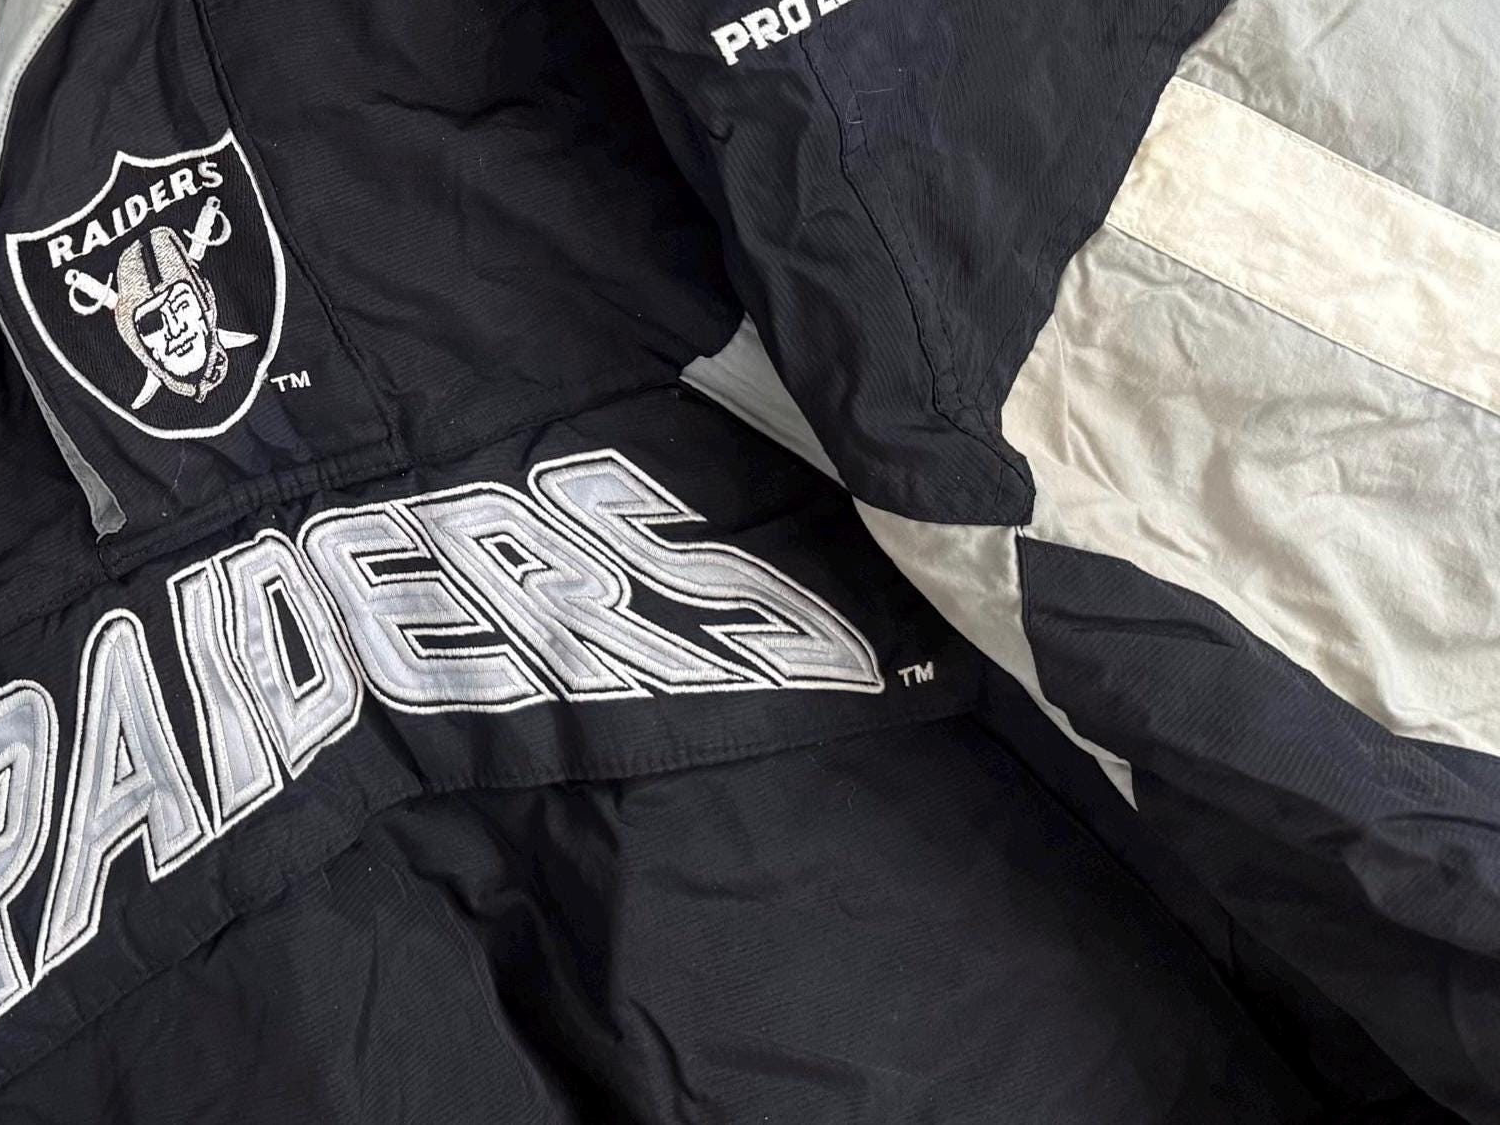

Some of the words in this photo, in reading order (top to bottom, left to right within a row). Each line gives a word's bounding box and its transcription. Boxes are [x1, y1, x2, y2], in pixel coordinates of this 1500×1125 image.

[46, 160, 225, 270] RAIDERS
[269, 369, 312, 393] TM
[897, 660, 934, 687] TM
